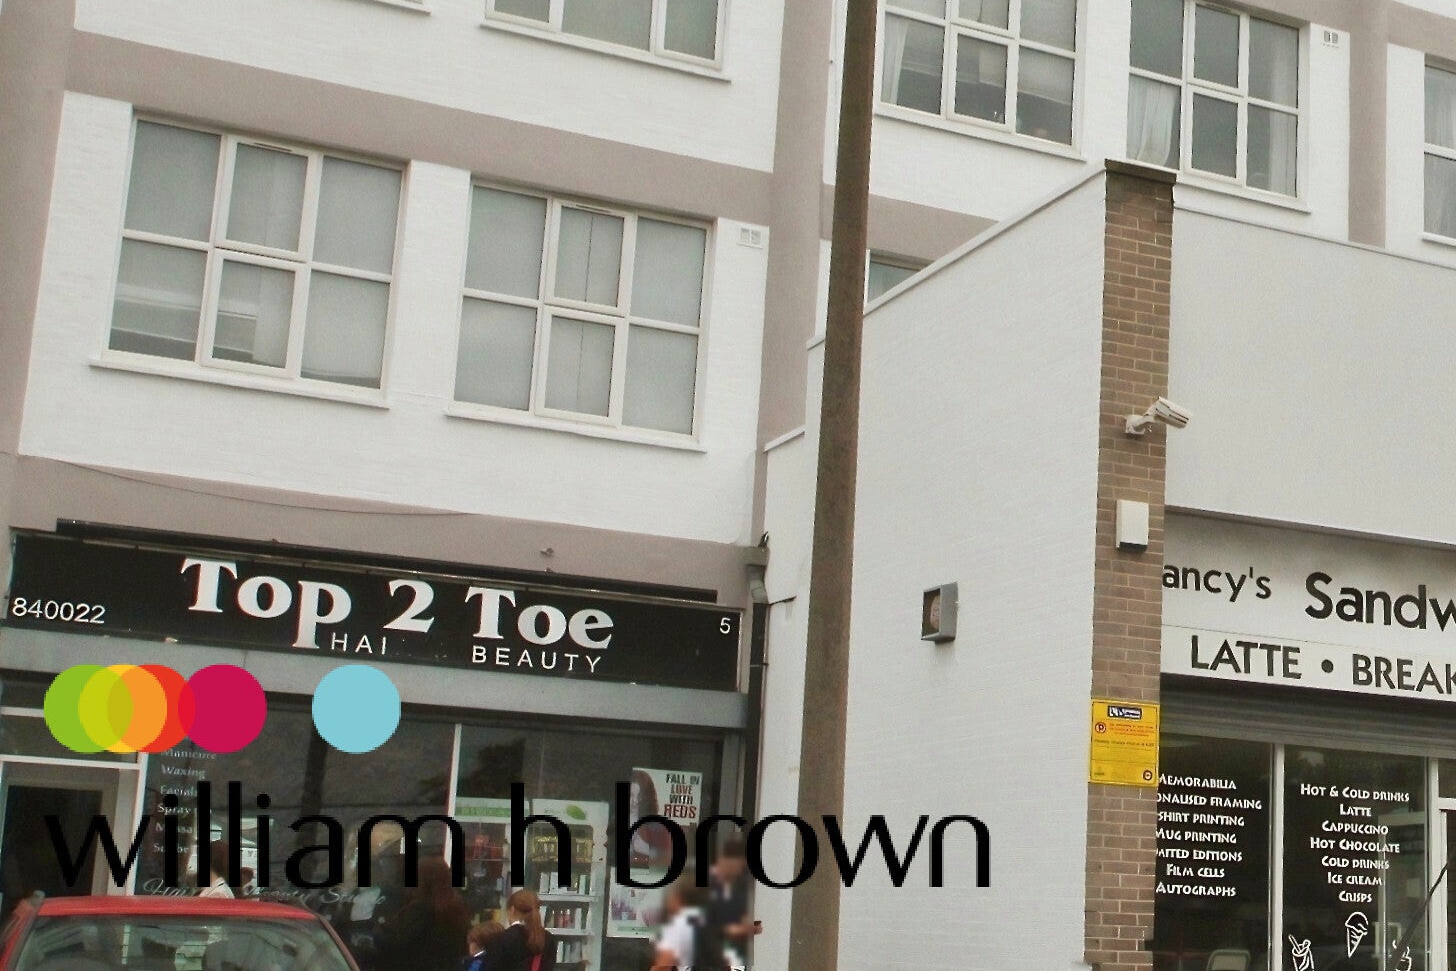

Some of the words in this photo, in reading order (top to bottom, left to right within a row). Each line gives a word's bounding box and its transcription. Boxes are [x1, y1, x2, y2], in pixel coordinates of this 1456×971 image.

[11, 597, 106, 625] 840022
[181, 558, 351, 649] Top
[383, 579, 435, 633] 2
[464, 586, 614, 650] Toe
[719, 617, 731, 634] 5
[472, 645, 602, 673] BEAUTY
[1191, 635, 1302, 680] LATTE
[160, 764, 206, 781] Waxing
[1300, 783, 1326, 796] HOT
[1329, 786, 1338, 797] &
[1342, 786, 1370, 799] COLD
[1373, 791, 1410, 802] DRINKS
[1210, 796, 1262, 810] FRAMING
[1340, 803, 1372, 817] LATTE
[664, 804, 697, 819] REDS
[1193, 813, 1245, 826] PRINTING
[1321, 820, 1389, 835] CAPPUCCINO
[1184, 831, 1237, 844] PRINTING
[1310, 837, 1335, 849] HOT
[1339, 839, 1400, 853] CHOCOLATE
[1193, 850, 1243, 862] EDITIONS
[1321, 856, 1349, 867] COLD
[1166, 863, 1194, 877] FILM
[1197, 868, 1225, 878] CELLS
[1327, 872, 1342, 884] ICE
[1346, 875, 1382, 886] CREAM
[1156, 882, 1237, 897] AUTOGRAPHS
[1338, 890, 1372, 903] CRISPS
